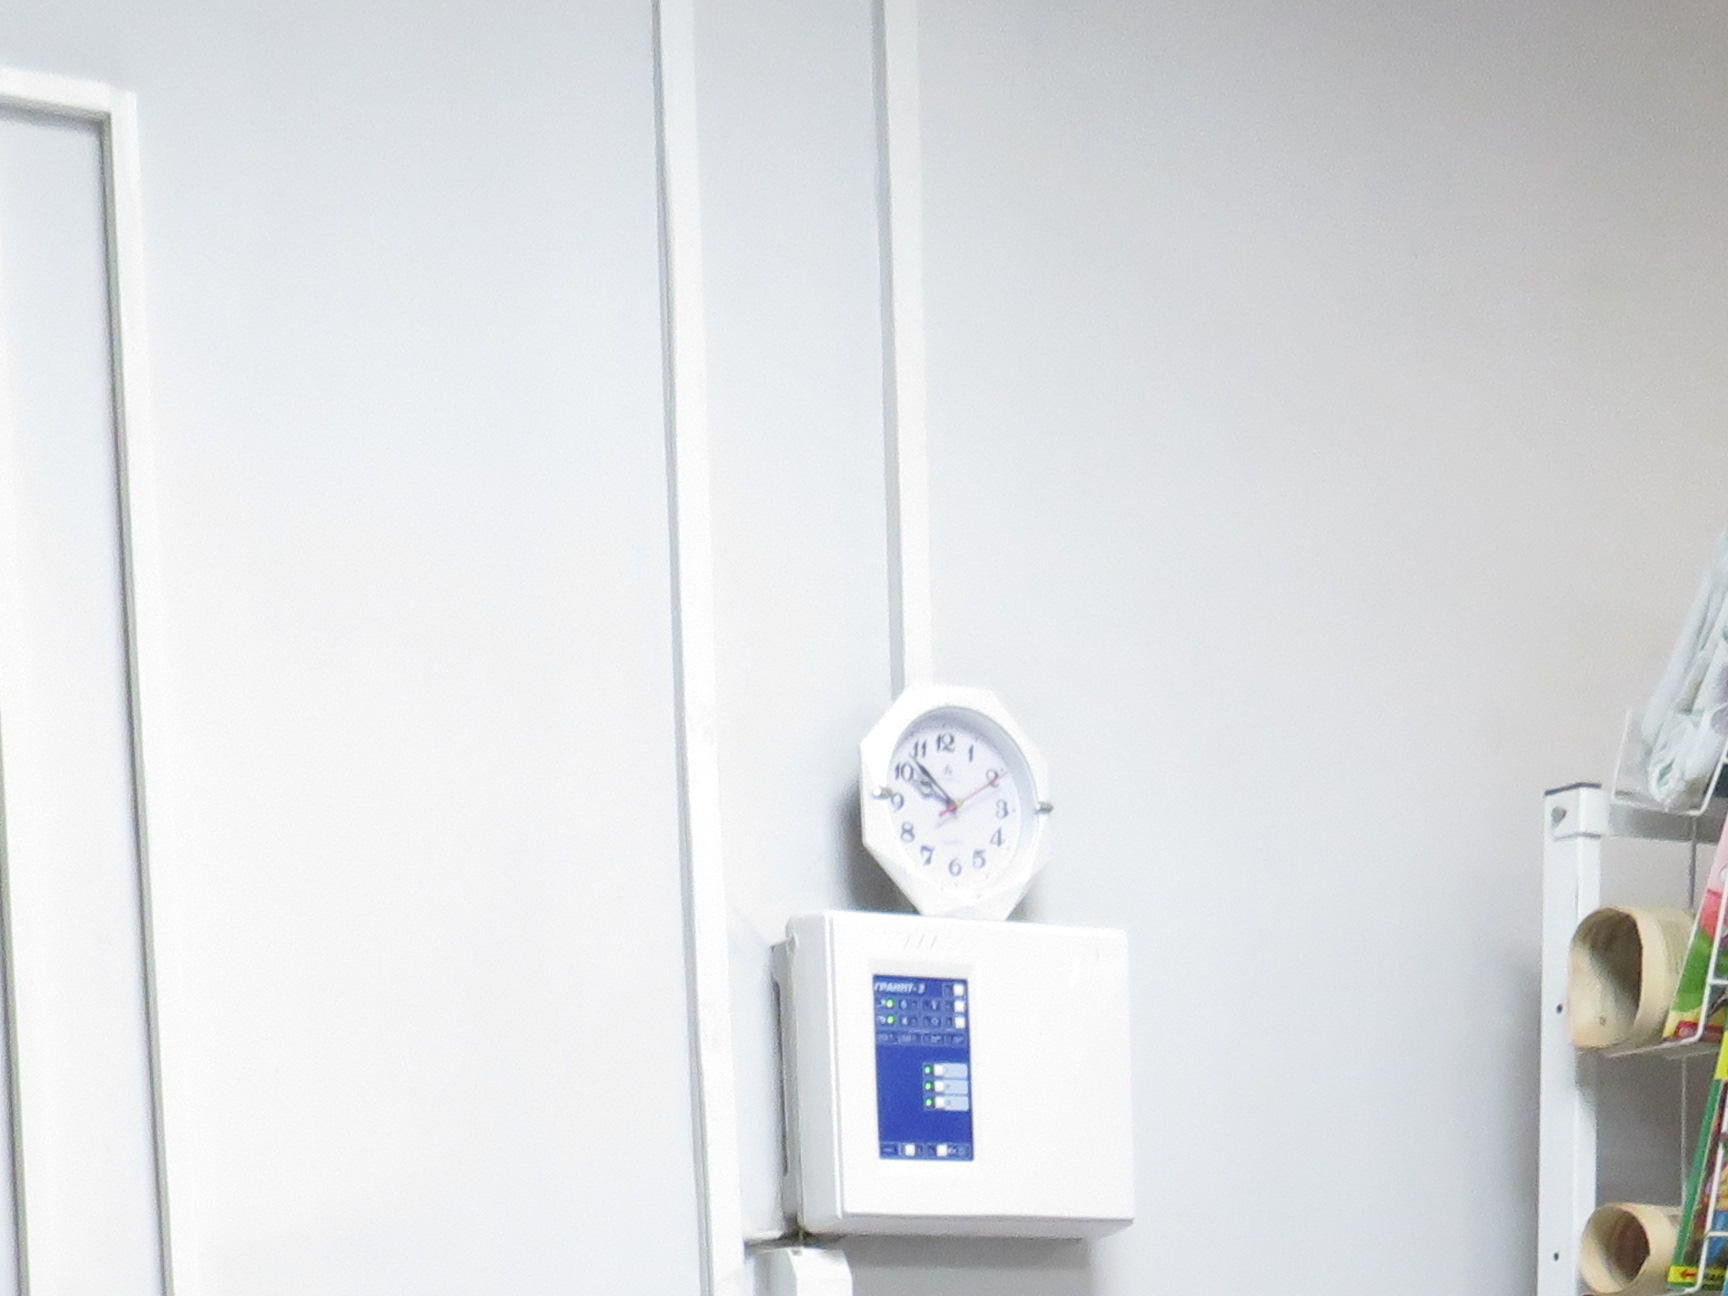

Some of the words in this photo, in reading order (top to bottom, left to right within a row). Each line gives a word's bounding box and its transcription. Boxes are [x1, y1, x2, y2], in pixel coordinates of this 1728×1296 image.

[913, 740, 928, 758] 11
[936, 732, 956, 753] 12
[967, 743, 975, 762] 1
[895, 761, 915, 782] 10
[985, 768, 1000, 788] 2
[891, 792, 905, 812] 9
[995, 799, 1009, 819] 3
[900, 821, 916, 844] 8
[989, 827, 1005, 847] 4
[920, 845, 935, 866] 7
[972, 849, 987, 870] 5
[948, 857, 962, 877] 6
